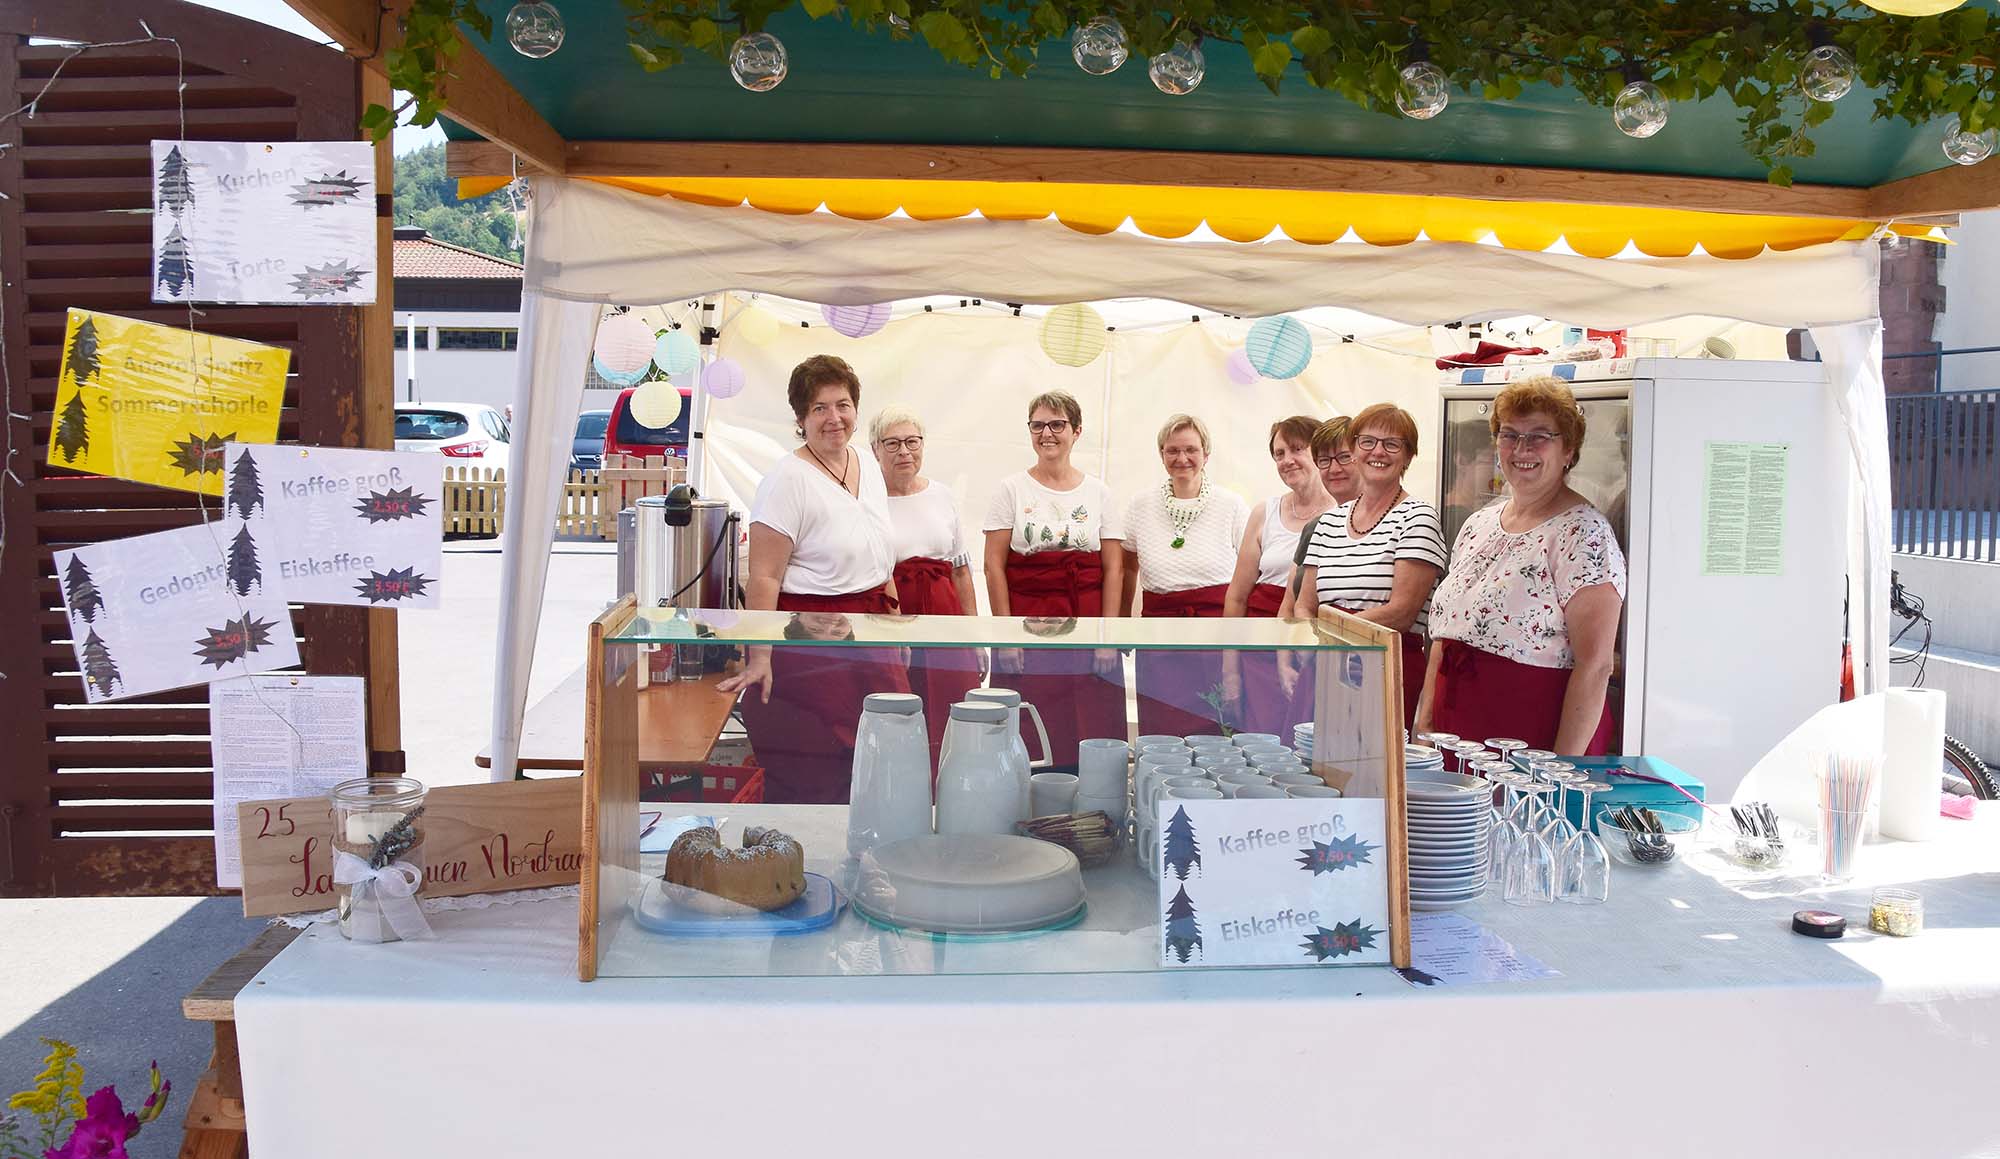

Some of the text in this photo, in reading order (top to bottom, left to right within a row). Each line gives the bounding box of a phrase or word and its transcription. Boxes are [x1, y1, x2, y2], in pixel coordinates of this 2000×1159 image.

[217, 167, 297, 195] Kuchen
[227, 256, 287, 281] Torte
[97, 395, 269, 414] Sommerschorle
[281, 467, 403, 499] Kaffee groß
[280, 552, 375, 580] Eiskaffee
[254, 803, 295, 839] 25
[1218, 813, 1346, 857] Kaffee groß
[1220, 908, 1320, 942] Eiskaffee
